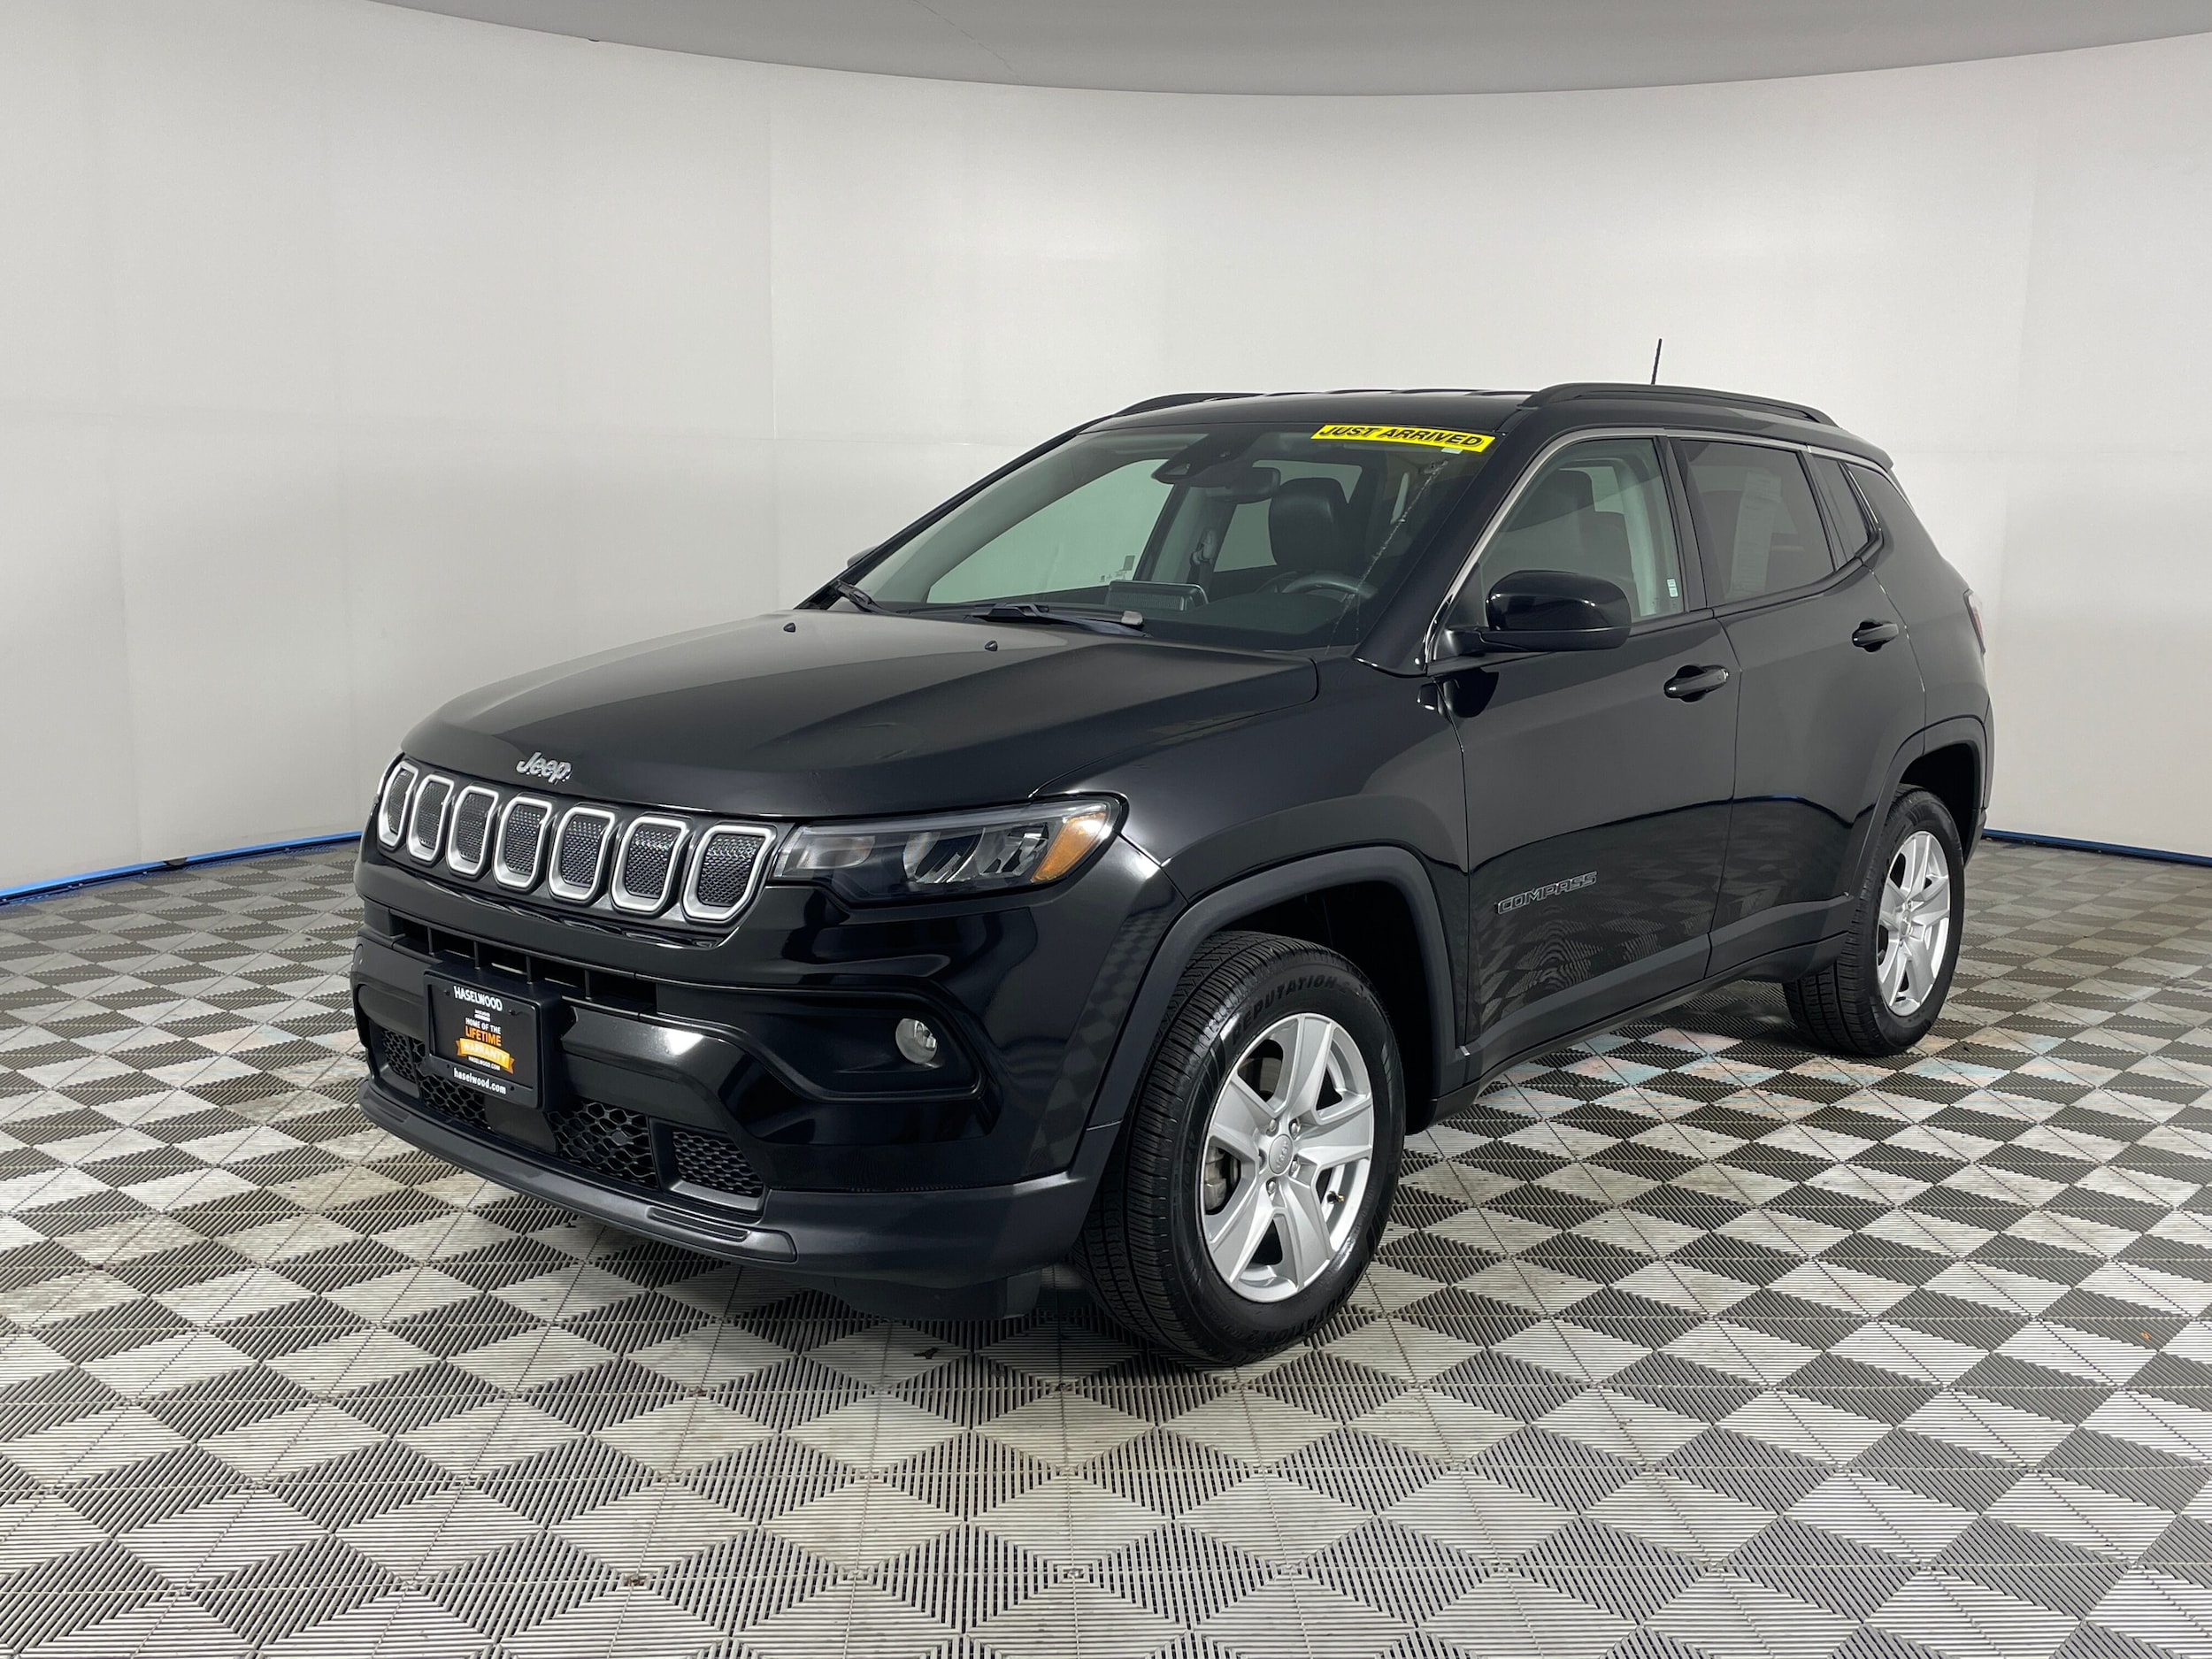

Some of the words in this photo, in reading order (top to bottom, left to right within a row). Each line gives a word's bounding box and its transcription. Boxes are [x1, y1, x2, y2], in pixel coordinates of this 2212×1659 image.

[1319, 426, 1381, 436] JUST
[1377, 427, 1485, 447] ARRIVED
[516, 751, 572, 783] Jeep
[1497, 871, 1597, 914] COMPASS
[453, 985, 503, 1011] HASELWOOD
[1231, 974, 1338, 1046] REPUTATION
[465, 1018, 480, 1030] HOME
[481, 1022, 489, 1032] OF
[490, 1025, 502, 1035] THE
[465, 1025, 502, 1047] LIFETIME
[463, 1041, 507, 1063] WARRANTY
[453, 1067, 506, 1094] haselwood.com
